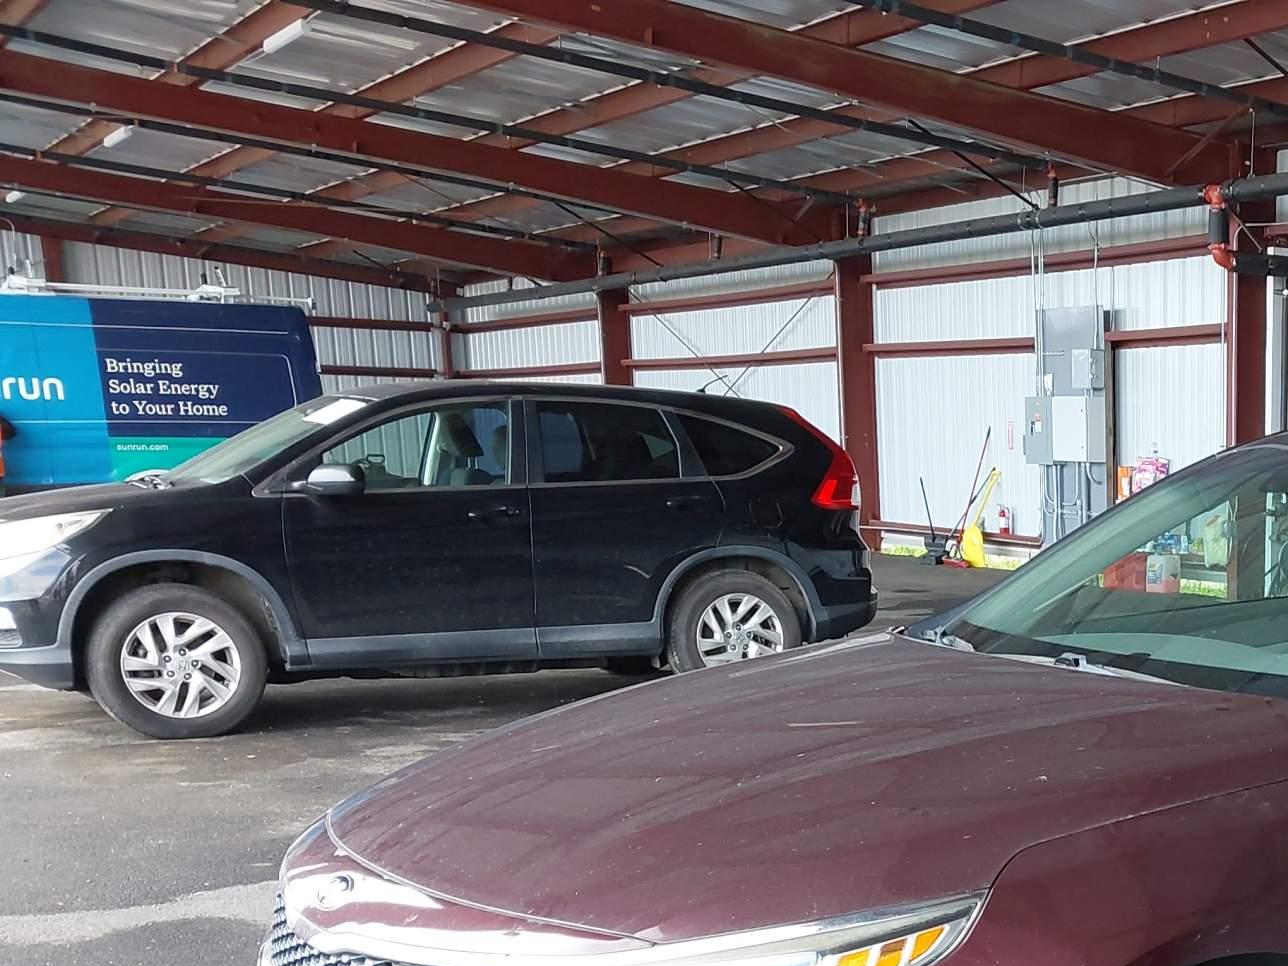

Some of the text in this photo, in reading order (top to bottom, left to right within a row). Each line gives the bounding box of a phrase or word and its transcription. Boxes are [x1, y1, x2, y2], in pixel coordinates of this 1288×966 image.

[105, 357, 183, 377] Bringing
[108, 378, 219, 399] Solar Energy
[111, 400, 228, 416] to Your Home
[116, 443, 169, 451] sunrun.com
